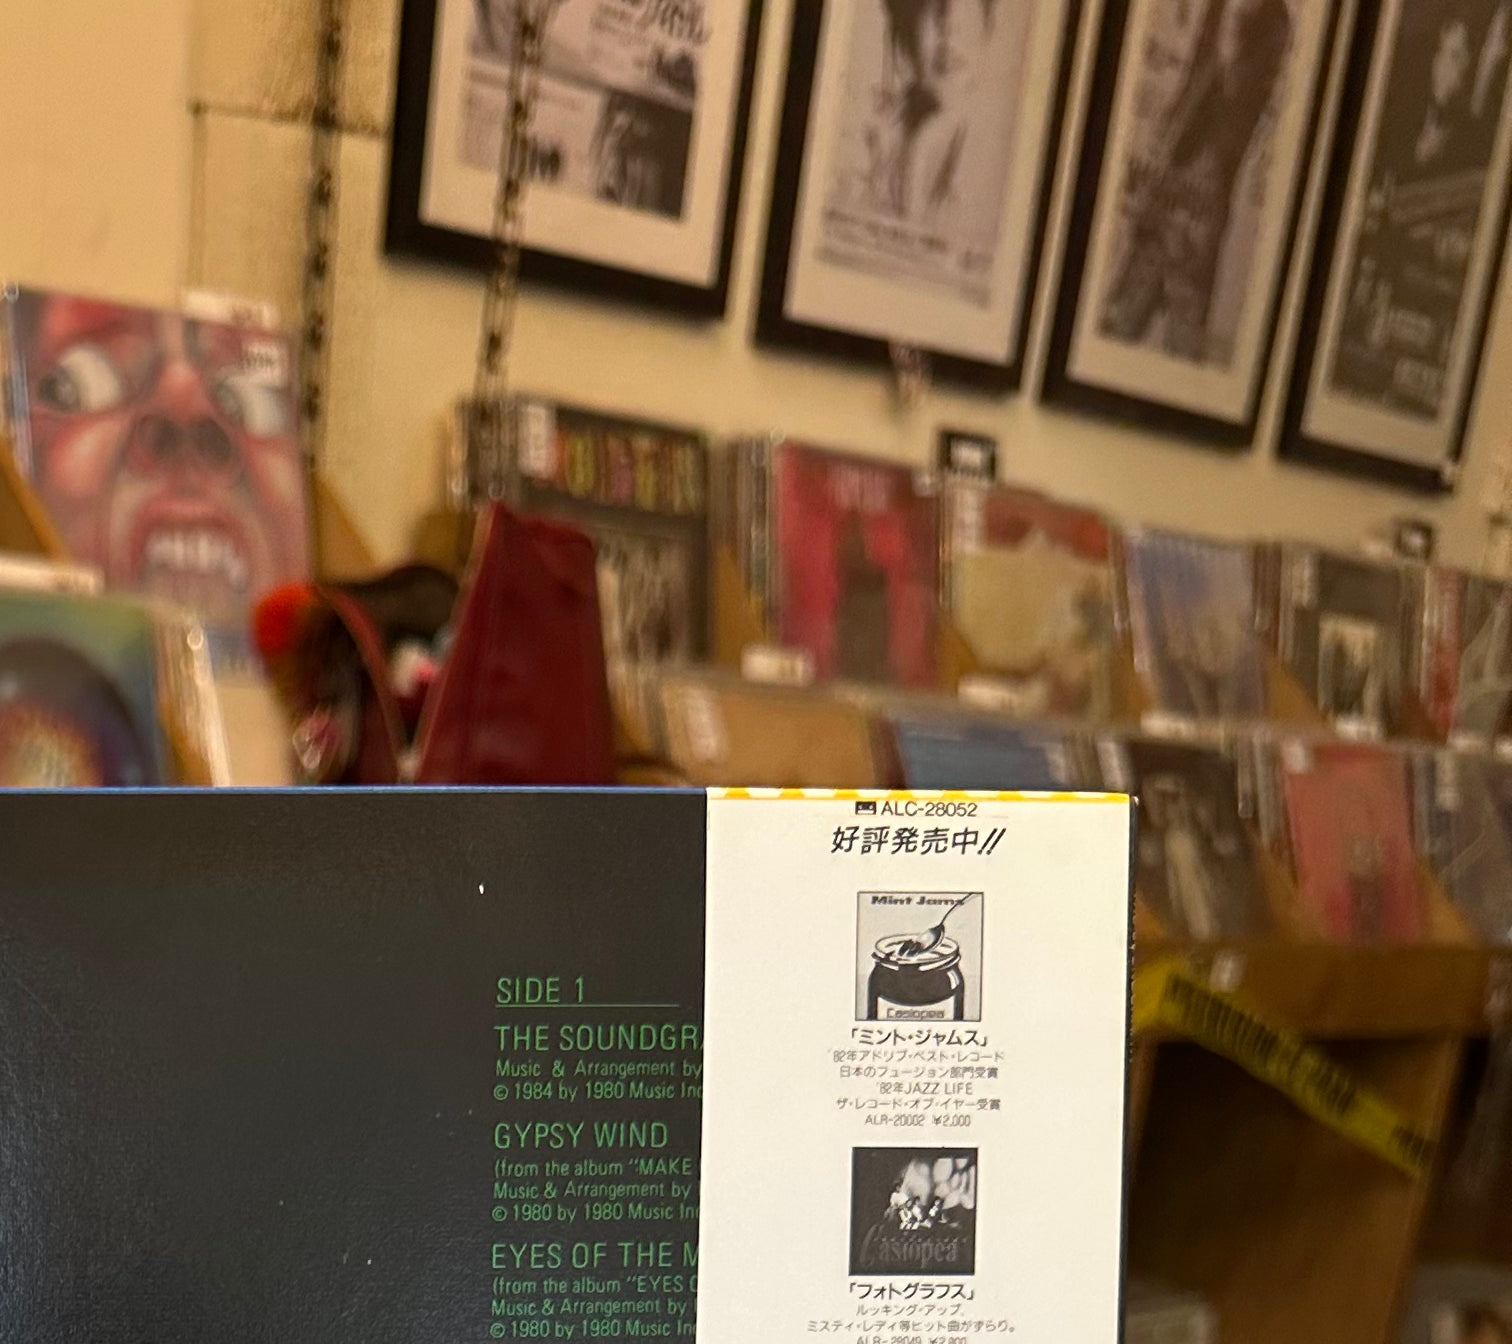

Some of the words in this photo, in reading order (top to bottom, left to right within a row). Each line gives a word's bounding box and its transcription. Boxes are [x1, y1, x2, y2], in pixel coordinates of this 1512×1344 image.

[880, 802, 977, 817] ALC-28052
[496, 977, 560, 1003] SIDE
[575, 976, 584, 1003] 1
[494, 1025, 550, 1051] THE
[559, 1024, 703, 1051] SOUNDGR
[496, 1060, 541, 1077] Music
[551, 1060, 565, 1078] &
[574, 1060, 675, 1078] Arrangement
[683, 1060, 702, 1078] by
[515, 1082, 552, 1099] 1984
[558, 1082, 578, 1102] by
[586, 1082, 624, 1098] 1980
[629, 1082, 675, 1098] Music
[944, 1081, 973, 1095] LIFE
[494, 1121, 584, 1149] GYPSY
[594, 1121, 668, 1149] WIND
[545, 1160, 570, 1177] the
[574, 1159, 623, 1177] album
[492, 1243, 562, 1269] EYES
[572, 1242, 607, 1269] OF
[618, 1242, 672, 1268] THE
